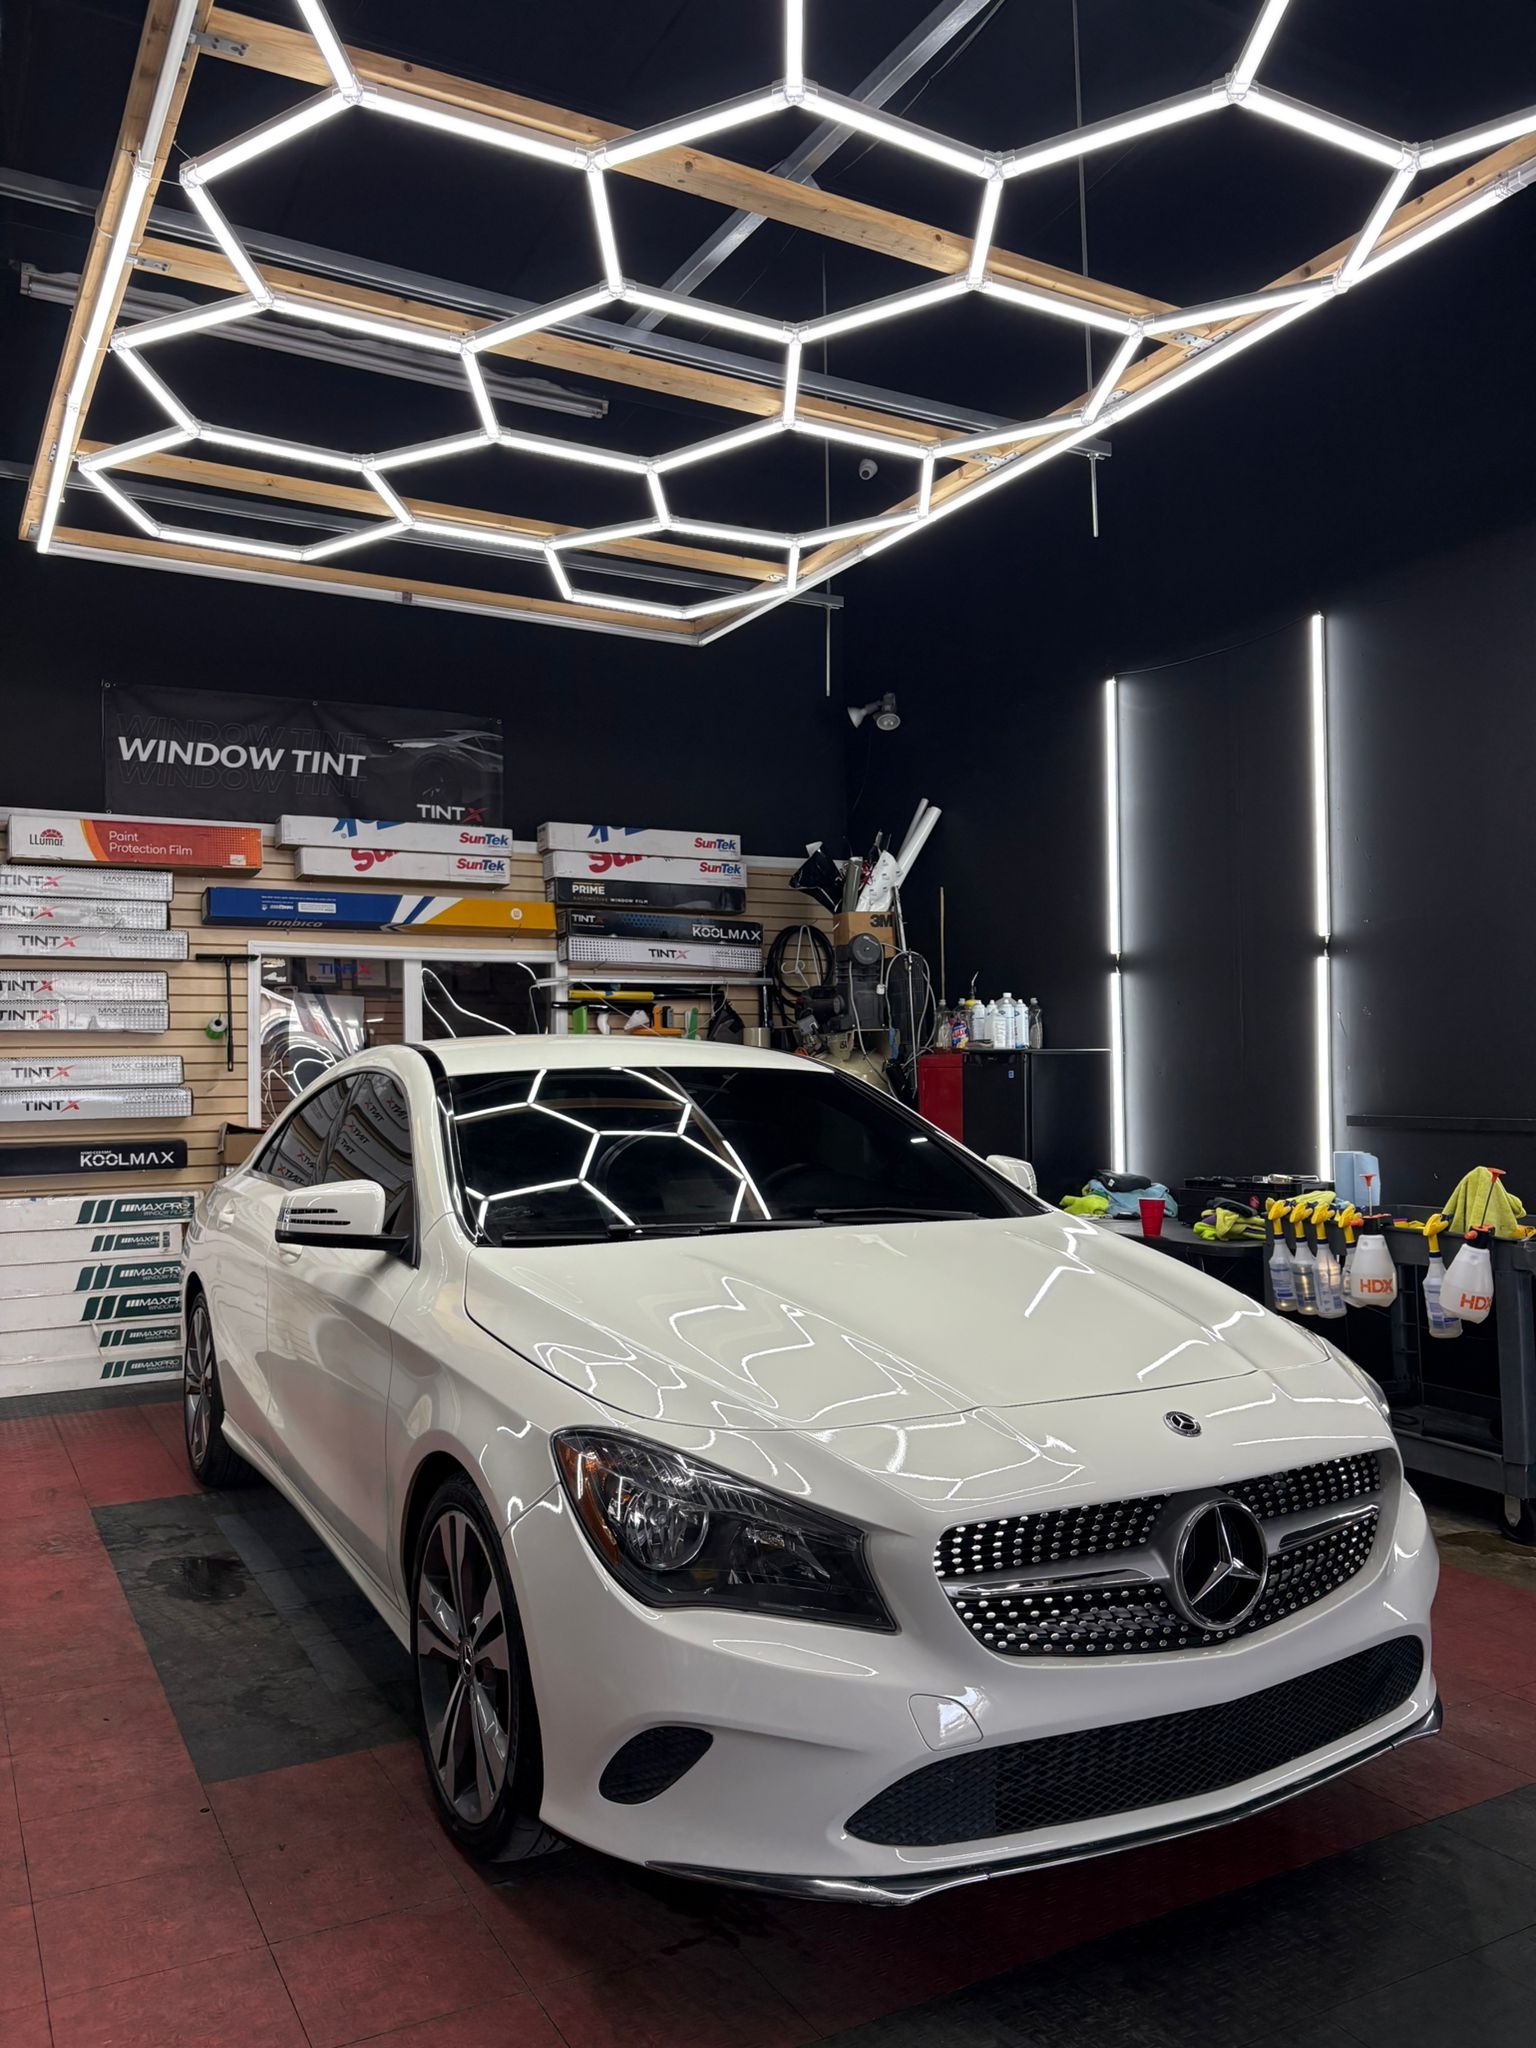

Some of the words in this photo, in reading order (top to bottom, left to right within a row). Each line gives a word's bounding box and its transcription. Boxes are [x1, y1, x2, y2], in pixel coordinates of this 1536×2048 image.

[118, 736, 285, 771] WINDOW
[291, 749, 366, 777] TINT
[416, 803, 488, 823] TINTX
[29, 833, 64, 846] LLumar
[108, 830, 139, 842] Paint
[459, 831, 510, 846] SunTek
[109, 842, 167, 855] Protection
[169, 844, 193, 856] Film
[694, 837, 736, 850] SunTek
[456, 857, 505, 872] SunTek
[699, 861, 741, 874] SunTek
[571, 884, 606, 895] PRIME
[870, 914, 893, 928] 3M
[692, 926, 761, 941] KOOLMAX
[17, 935, 81, 949] TINTX
[648, 948, 691, 960] TINTX
[80, 1151, 175, 1167] KOOLMAX
[134, 1200, 191, 1212] MAXPRO
[134, 1265, 182, 1277] MAXPR
[1359, 1278, 1393, 1294] HDX
